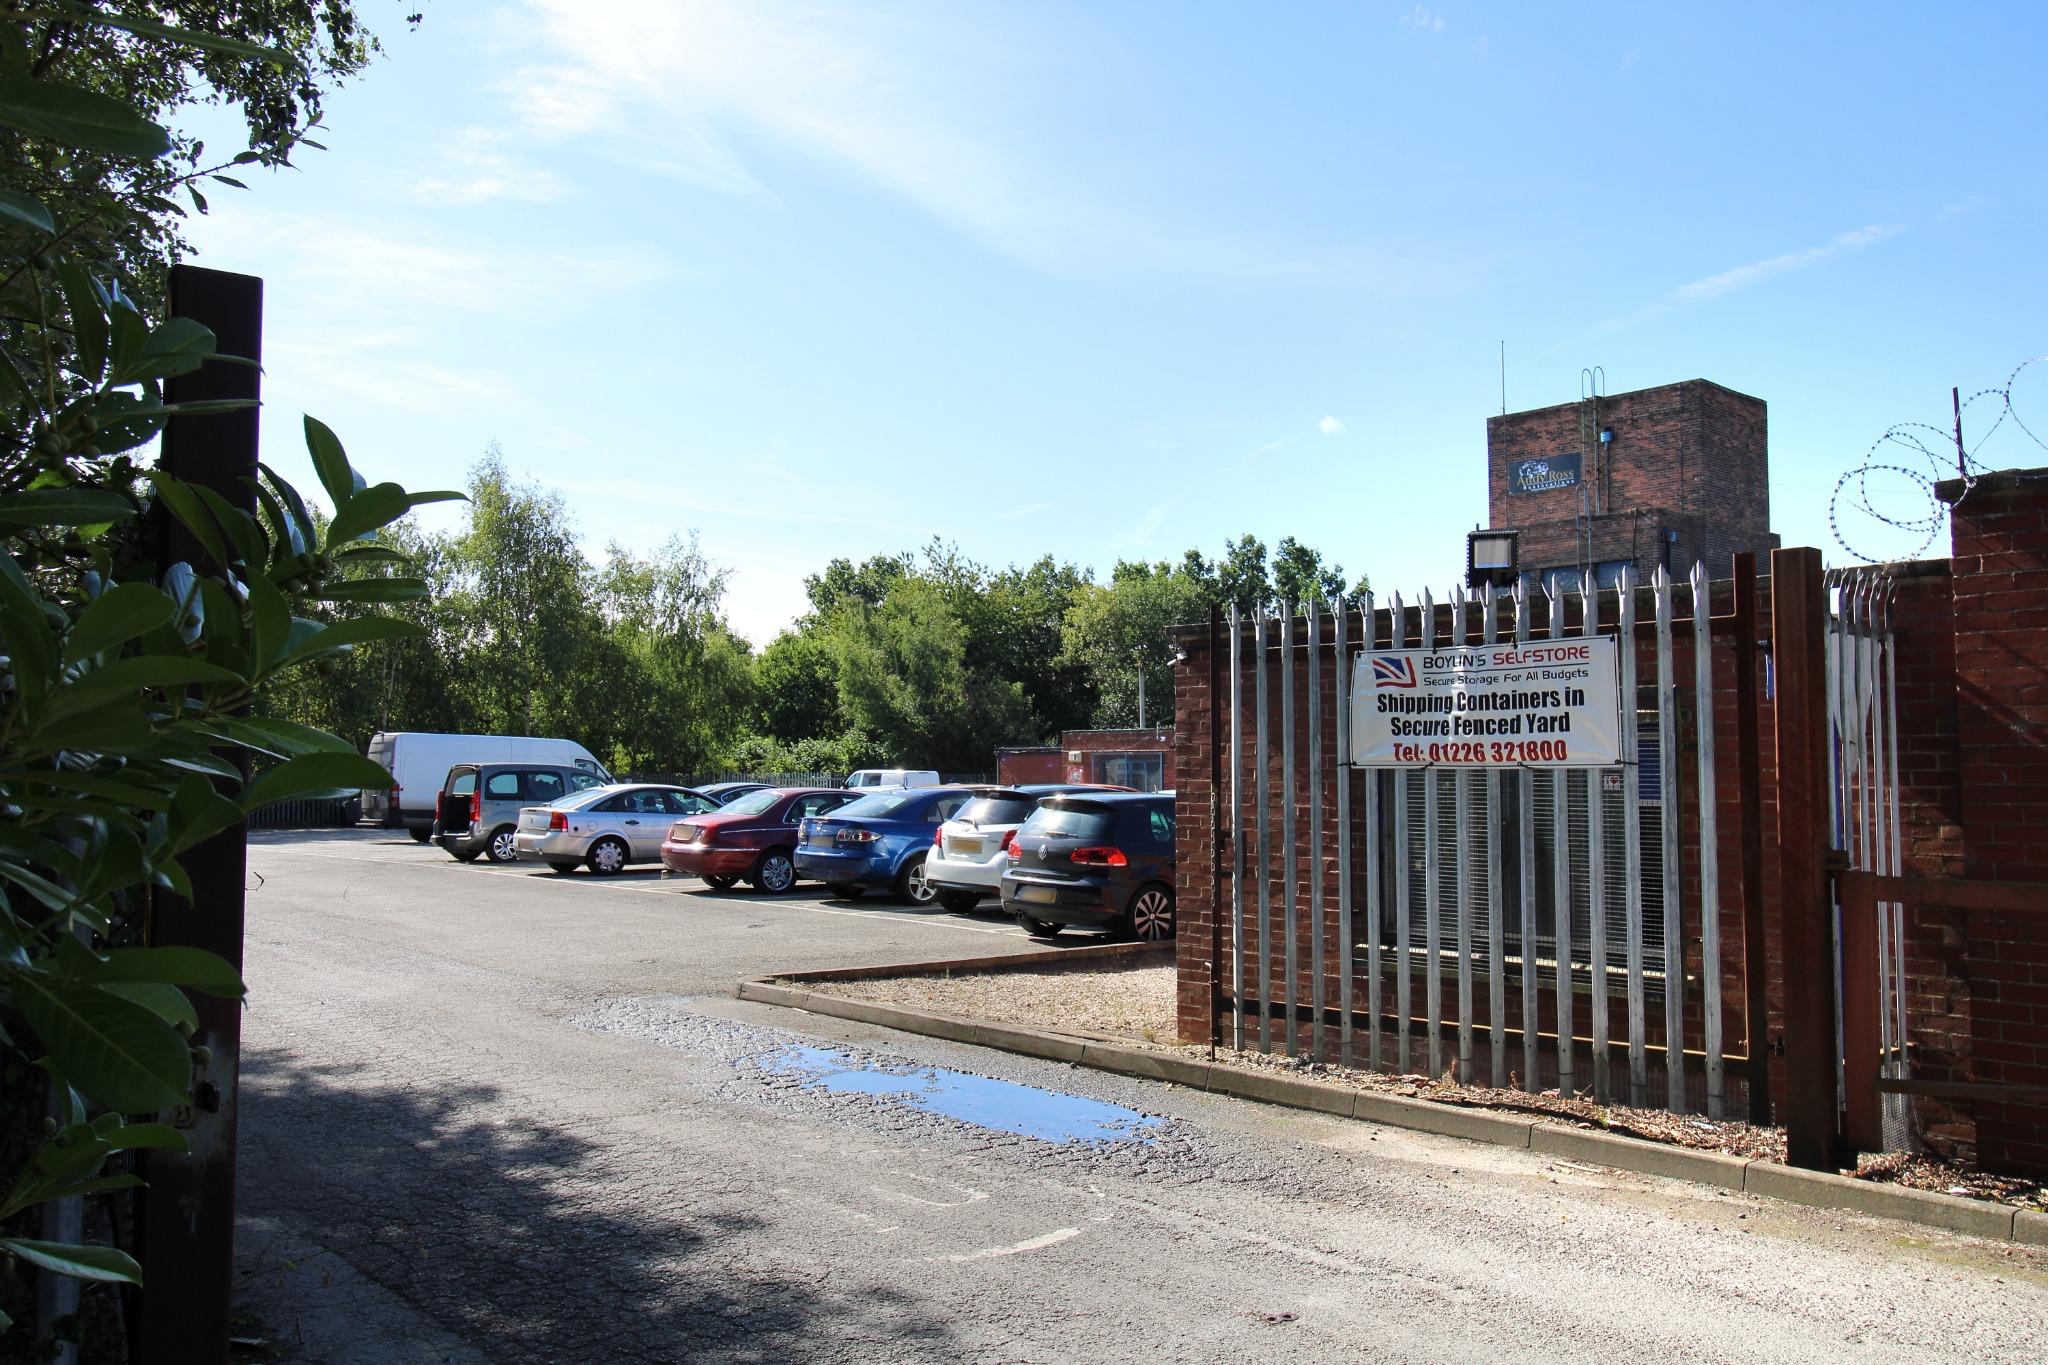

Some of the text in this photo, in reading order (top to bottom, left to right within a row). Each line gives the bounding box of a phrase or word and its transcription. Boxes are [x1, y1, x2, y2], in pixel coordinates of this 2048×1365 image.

[1517, 470, 1575, 486] Andy Ross
[1423, 645, 1590, 669] BOYLIN'S SELFSTORE
[1423, 668, 1589, 687] Secure Storage For All Budgets
[1377, 686, 1585, 715] Shipping Containers in
[1390, 711, 1571, 737] Secure Fenced Yard
[1393, 739, 1568, 762] Tel: 01226 321800
